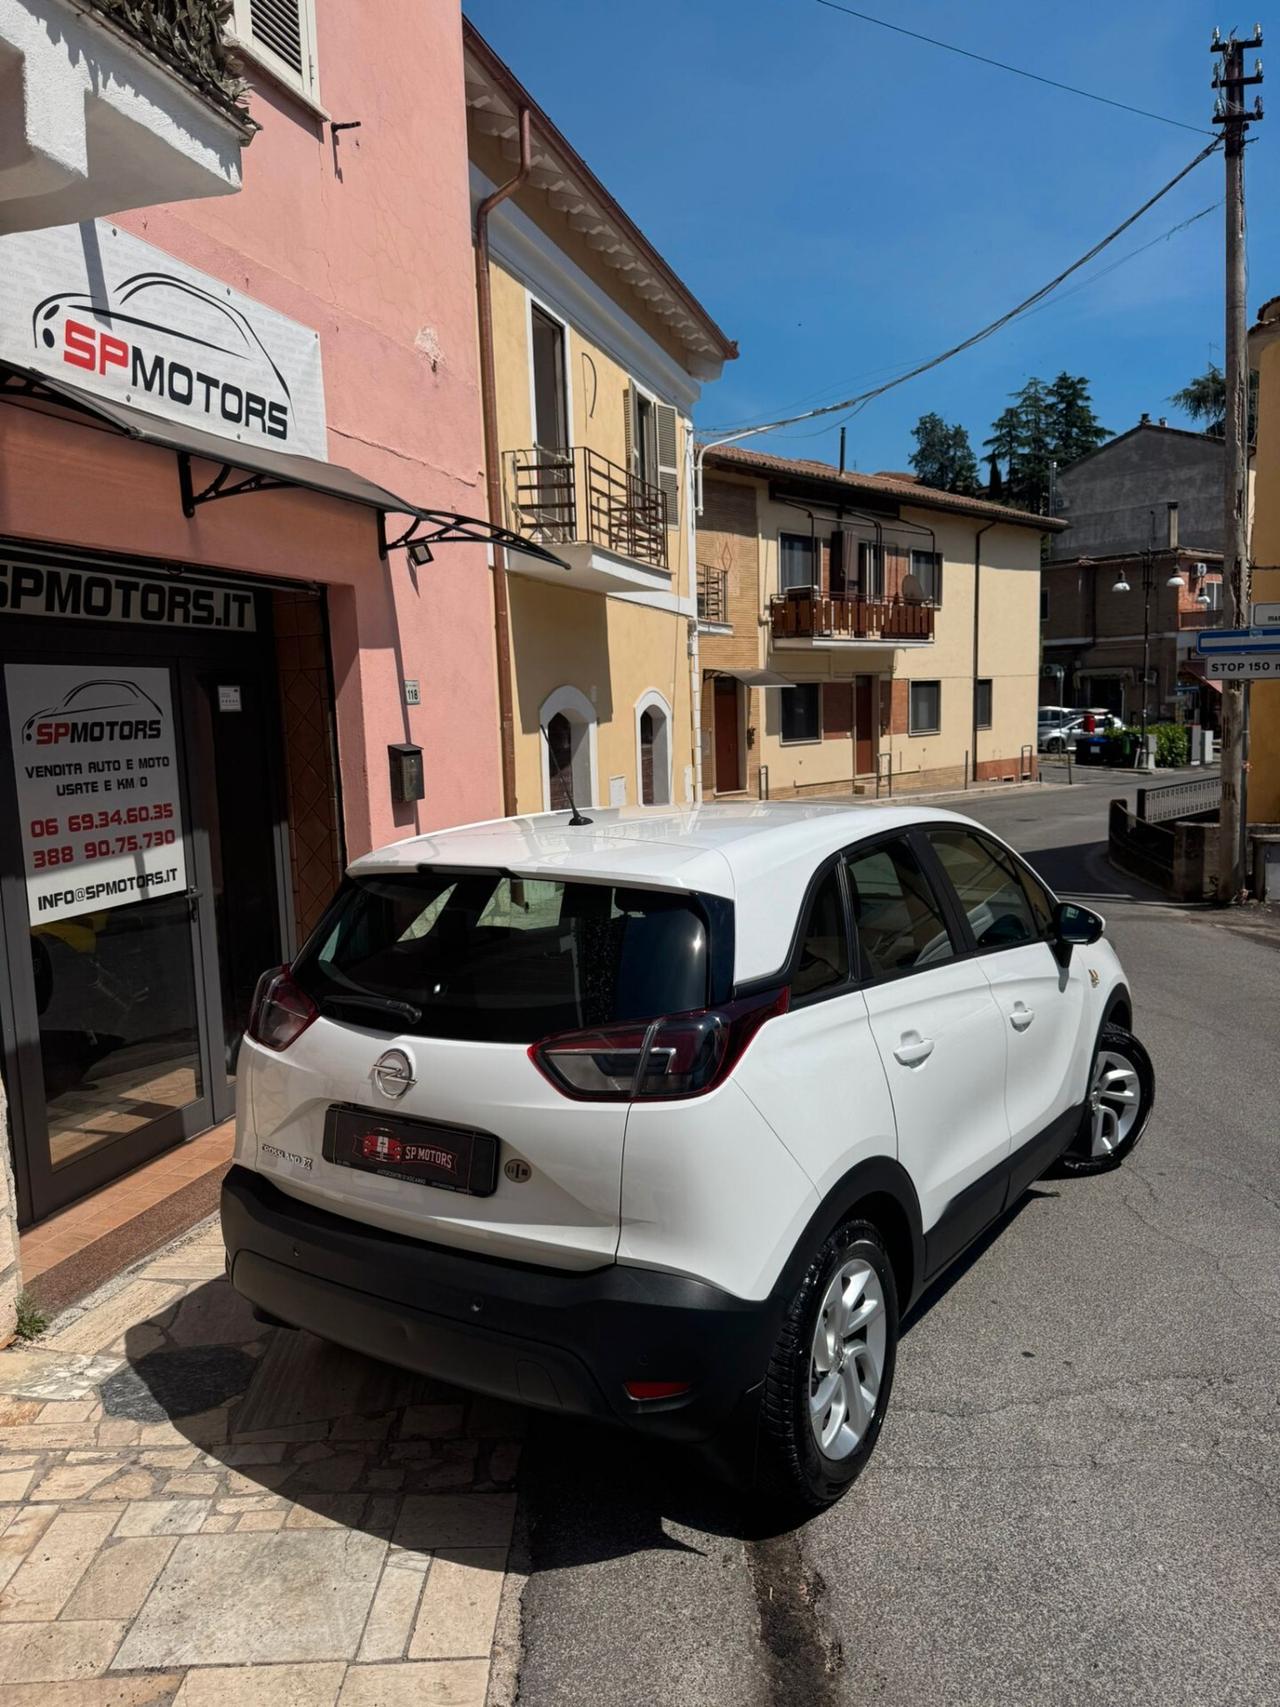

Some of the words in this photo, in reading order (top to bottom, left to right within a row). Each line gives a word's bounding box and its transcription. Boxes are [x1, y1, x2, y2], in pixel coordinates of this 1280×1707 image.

[63, 319, 288, 440] SPMOTORS
[0, 565, 252, 628] PMOTORS.IT
[1211, 663, 1245, 672] STOP
[1249, 662, 1270, 671] 150
[407, 689, 419, 700] 118
[36, 720, 161, 745] SPMOTORS
[25, 762, 83, 779] VENDITA
[88, 760, 121, 774] AUTO
[127, 759, 134, 770] E
[139, 756, 170, 769] MOTO
[56, 781, 99, 797] USATE
[104, 780, 112, 792] E
[117, 778, 135, 790] KM
[31, 818, 59, 838] 06
[68, 803, 173, 833] 69.34.60.35
[33, 846, 74, 869] 388
[84, 829, 176, 860] 90.75.730
[38, 868, 178, 911] INFO@SPMOTORS.IT
[405, 1146, 417, 1159] SP
[417, 1147, 453, 1168] MOTORS
